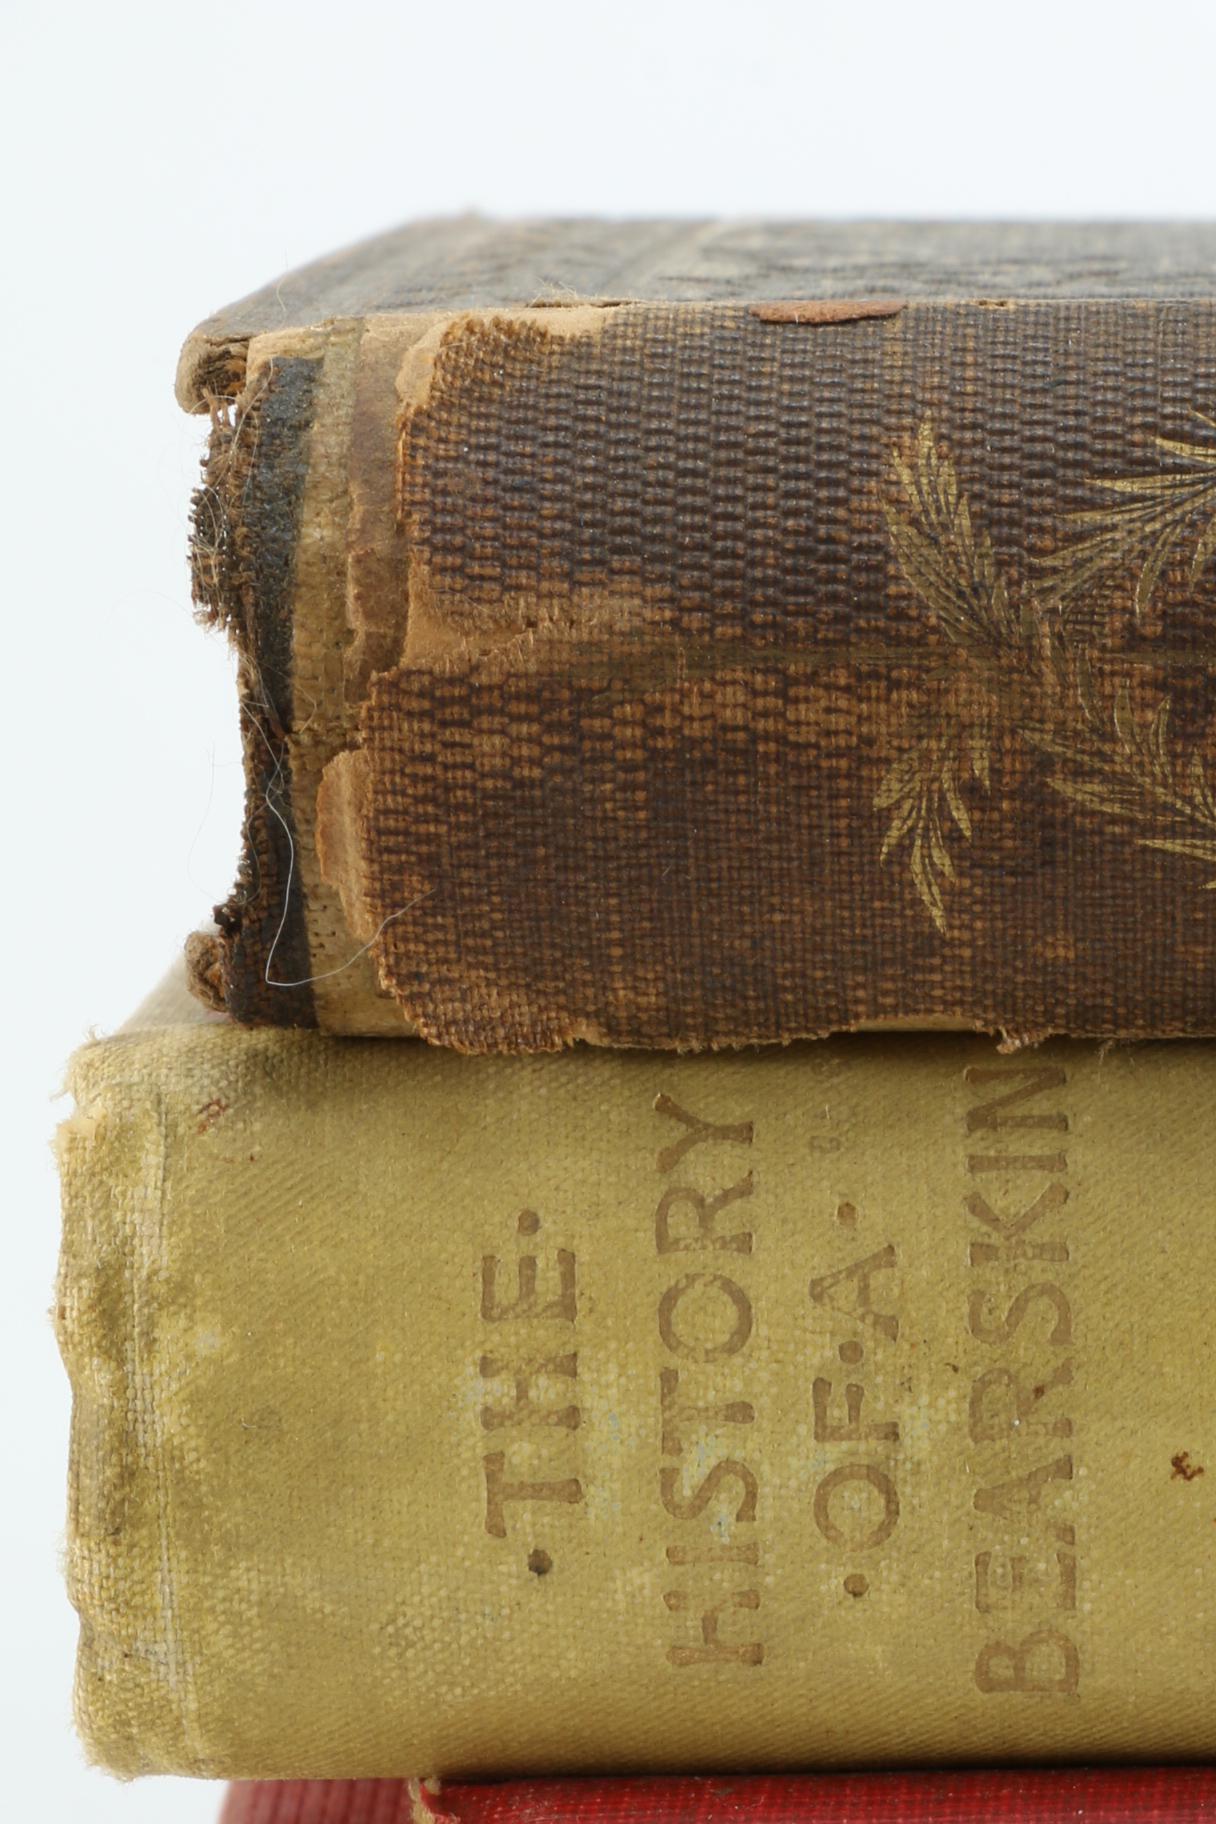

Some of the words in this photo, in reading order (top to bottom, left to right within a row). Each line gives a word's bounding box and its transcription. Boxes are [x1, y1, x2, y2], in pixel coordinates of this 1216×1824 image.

[479, 1249, 584, 1539] THE
[654, 1093, 764, 1668] HISTORY
[963, 1066, 1081, 1695] BEARSKIN
